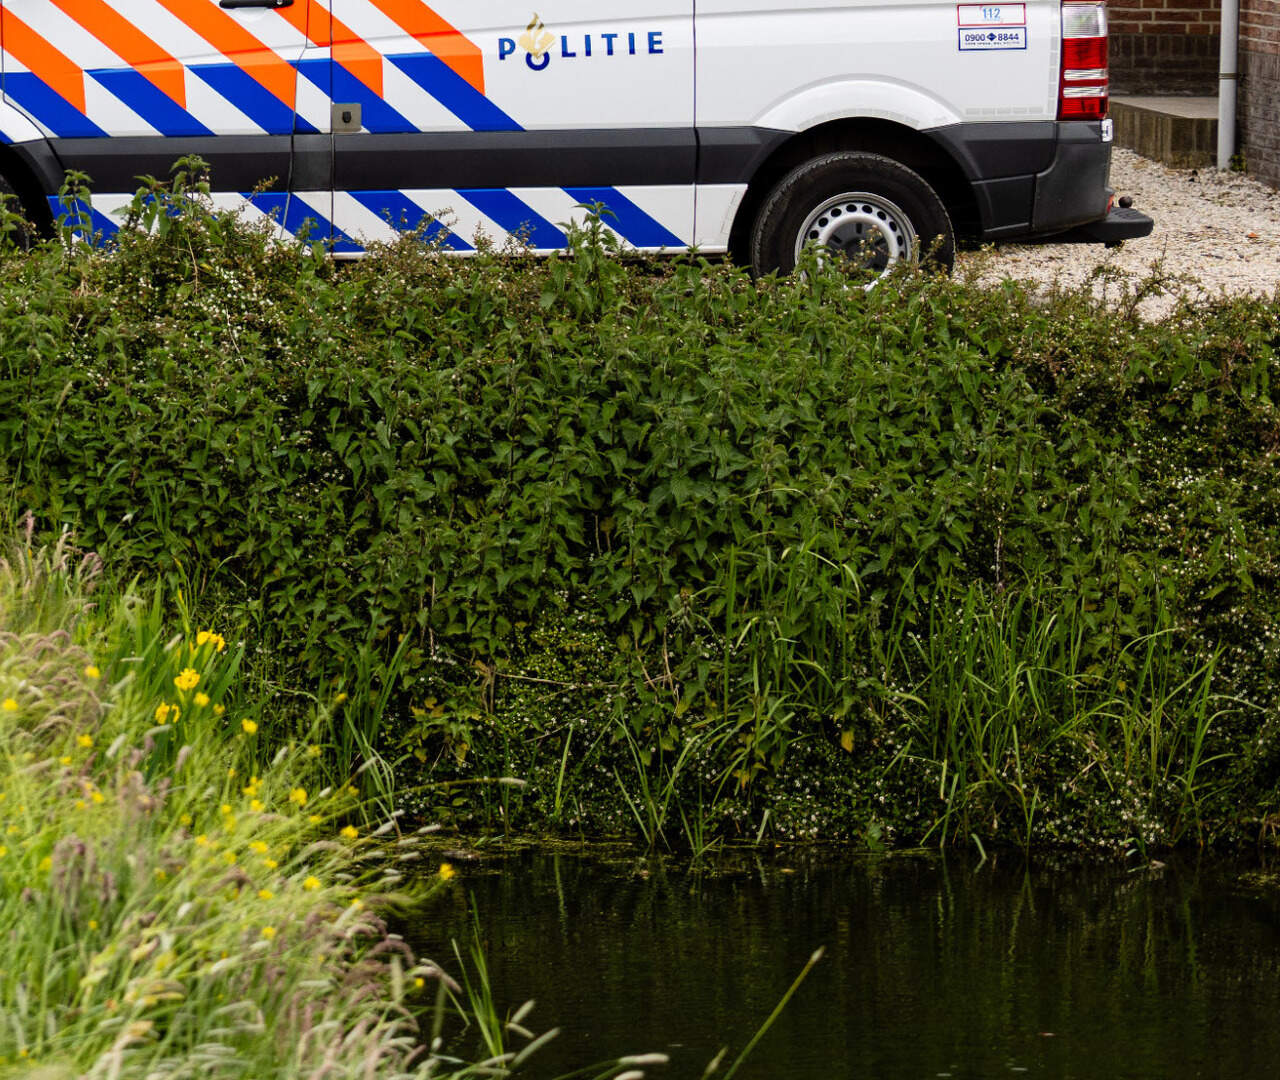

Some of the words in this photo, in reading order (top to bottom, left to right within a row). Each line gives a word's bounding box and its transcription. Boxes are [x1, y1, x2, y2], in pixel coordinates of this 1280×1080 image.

[983, 8, 1001, 20] 112
[965, 33, 986, 42] 0900
[997, 33, 1019, 41] 8844
[498, 31, 664, 71] POLITIE
